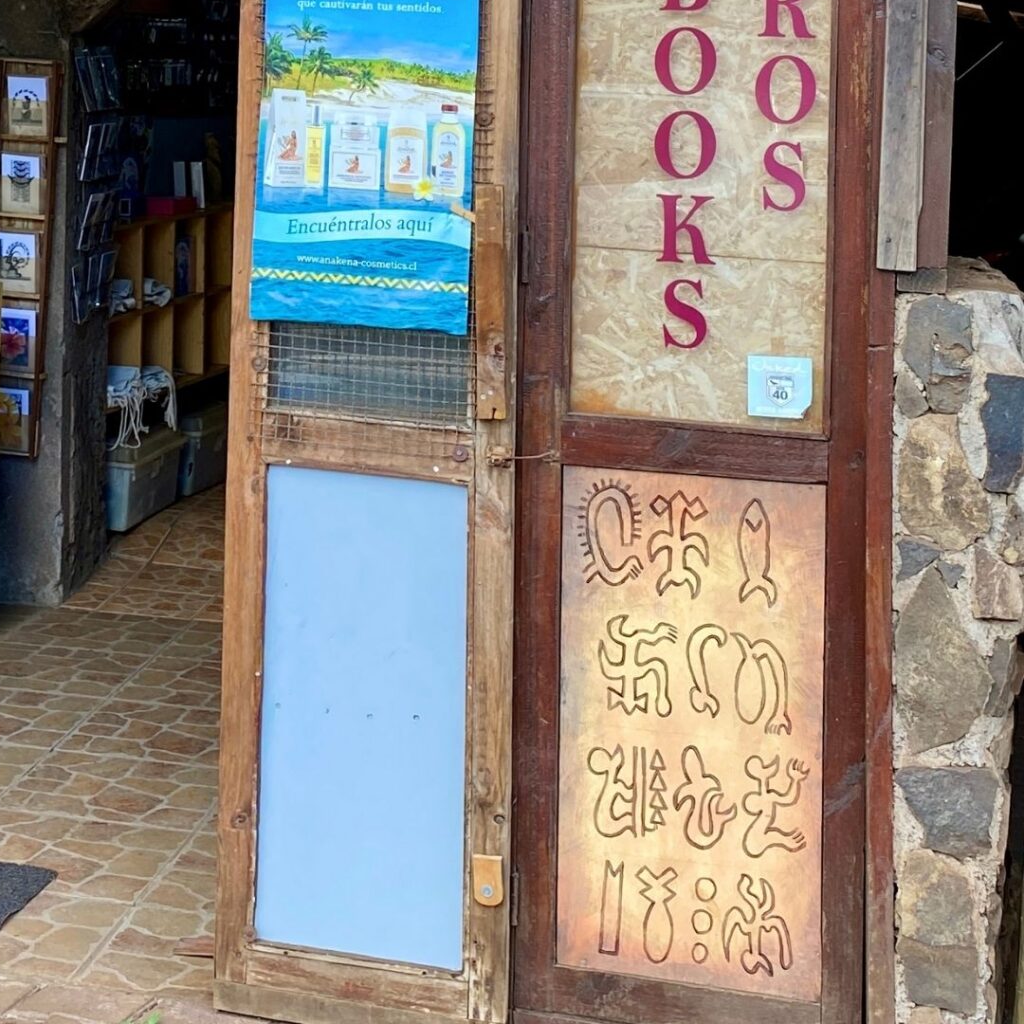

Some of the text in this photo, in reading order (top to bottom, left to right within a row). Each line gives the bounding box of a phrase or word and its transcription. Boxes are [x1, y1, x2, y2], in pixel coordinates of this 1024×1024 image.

[297, 1, 316, 11] que
[377, 1, 393, 11] tus
[286, 213, 435, 236] Encuéntralos aquí
[296, 254, 418, 272] www.anakena-cosmetics.cl
[772, 389, 789, 401] 40
